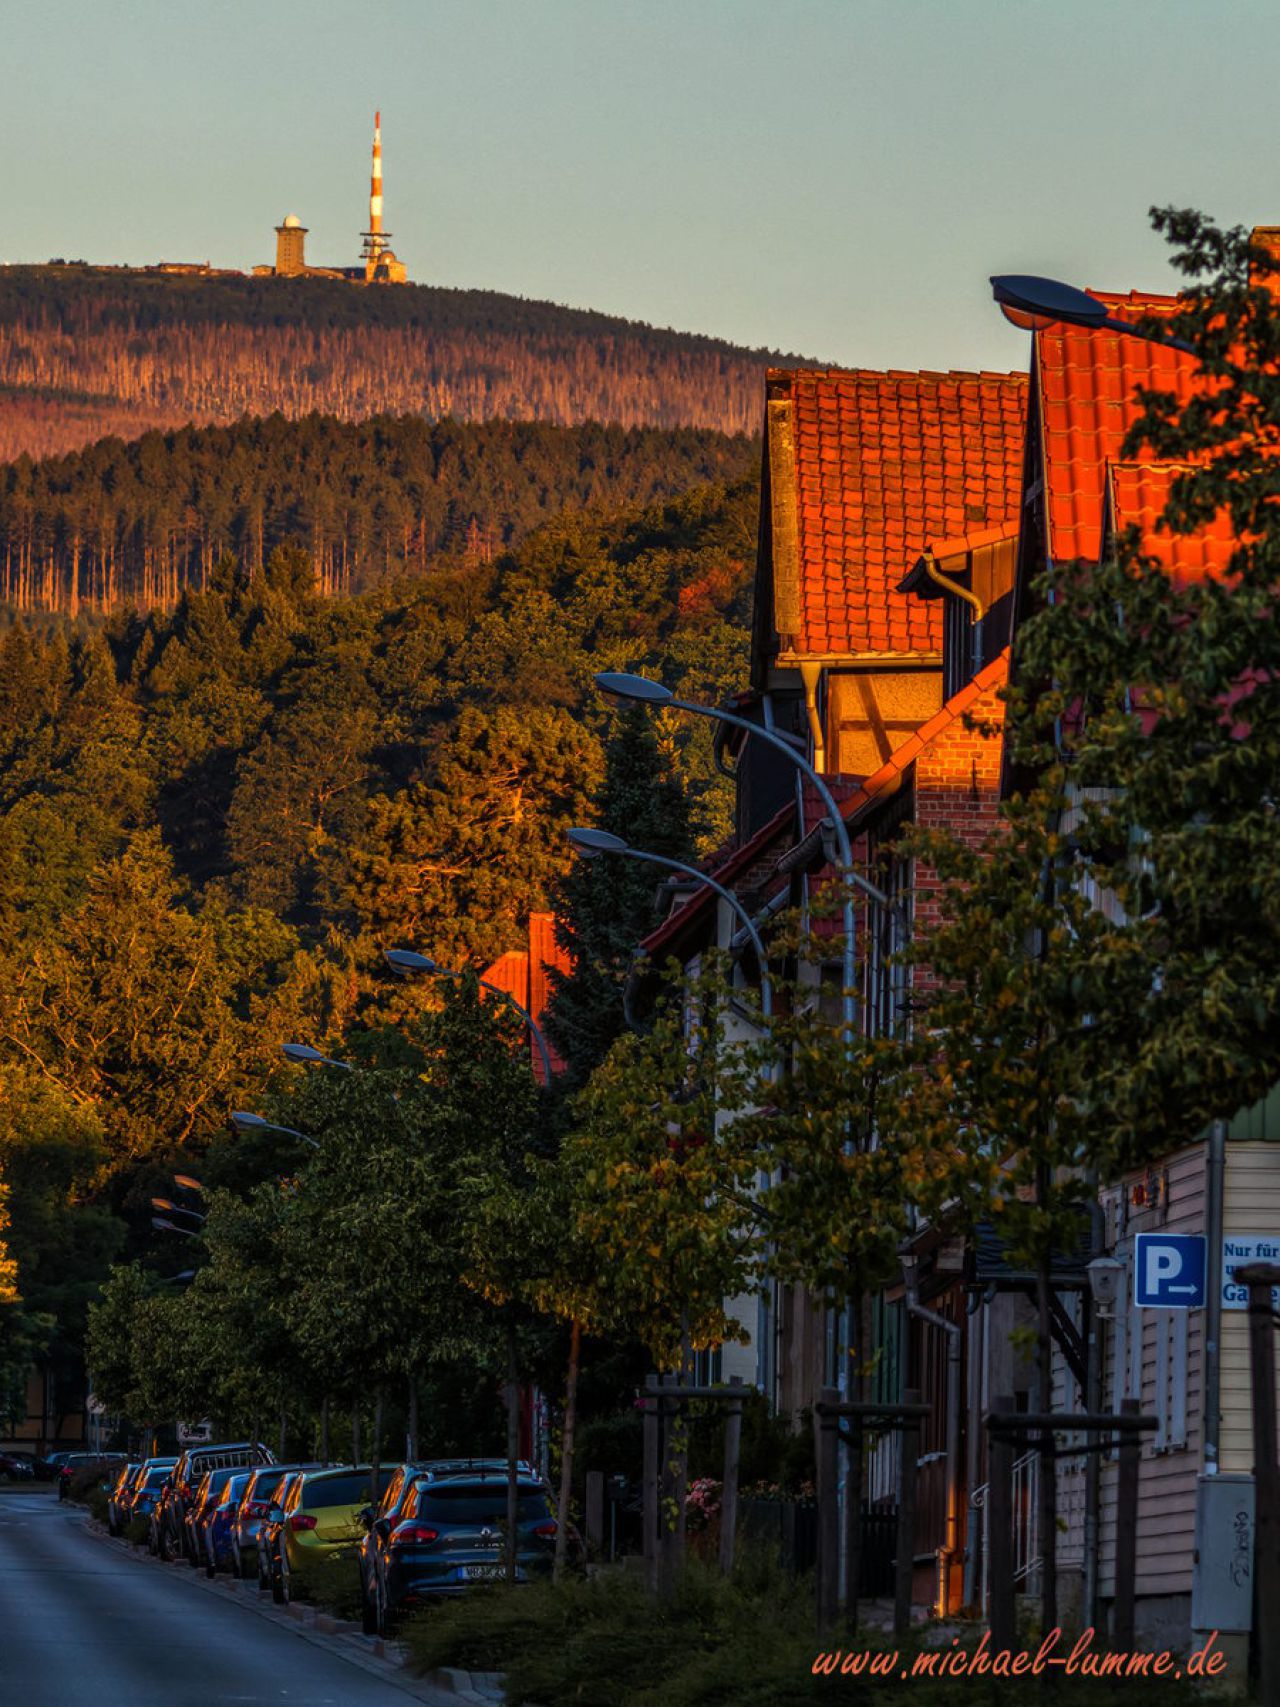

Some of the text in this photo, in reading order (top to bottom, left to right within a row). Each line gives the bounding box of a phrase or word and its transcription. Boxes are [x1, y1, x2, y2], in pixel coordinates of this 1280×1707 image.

[1224, 1242, 1278, 1257] Nur für
[1146, 1245, 1182, 1295] P
